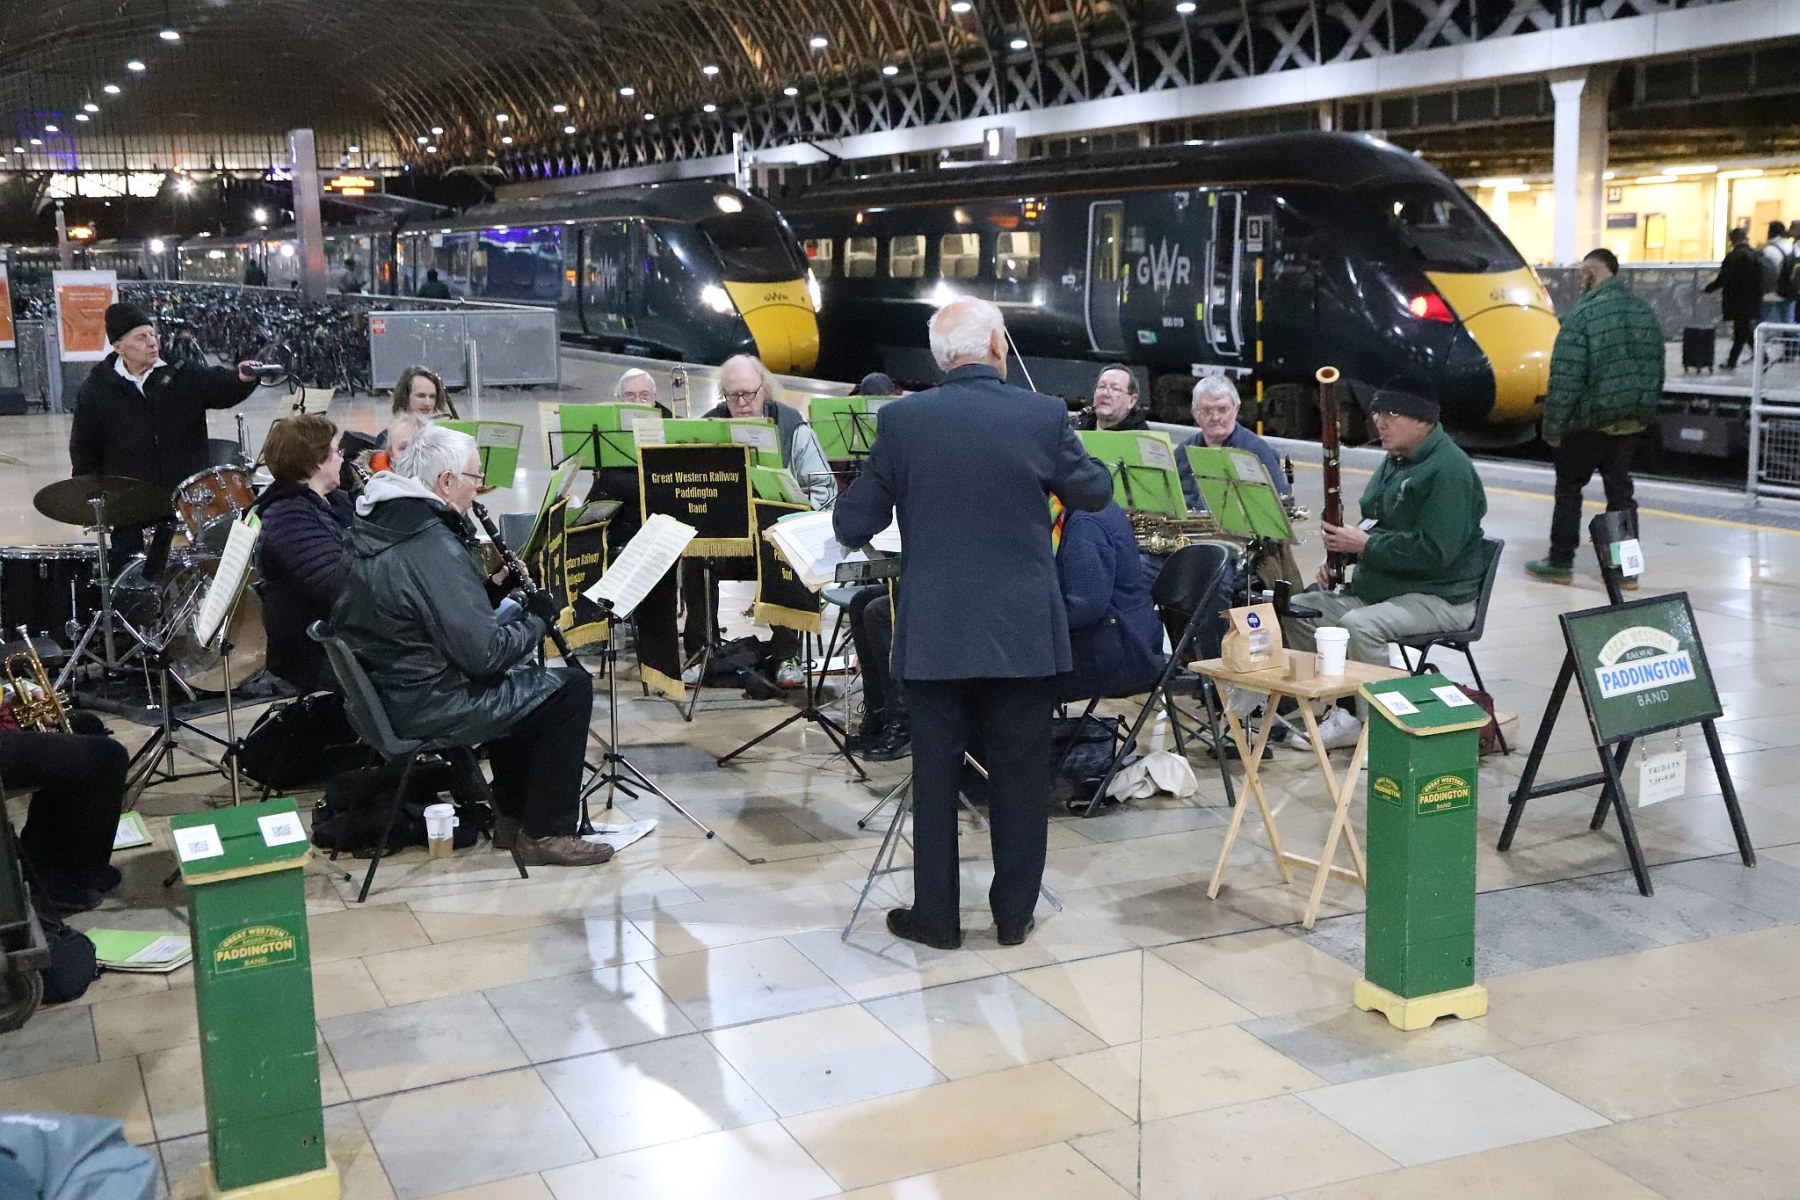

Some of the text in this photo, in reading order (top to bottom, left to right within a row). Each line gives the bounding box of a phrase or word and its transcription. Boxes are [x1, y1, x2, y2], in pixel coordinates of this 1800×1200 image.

[1137, 235, 1191, 293] GWR
[651, 470, 740, 484] Great Western Railway
[675, 487, 718, 499] Paddington
[688, 502, 707, 514] Band
[1601, 657, 1690, 691] PADDINGTON
[1637, 689, 1669, 707] BAND
[1424, 777, 1465, 793] GREAT WESTERN
[1419, 788, 1469, 804] PADDINGTON
[223, 927, 286, 948] GREAT WESTERN
[216, 939, 293, 962] PADDINGTON
[244, 957, 268, 967] BAND
